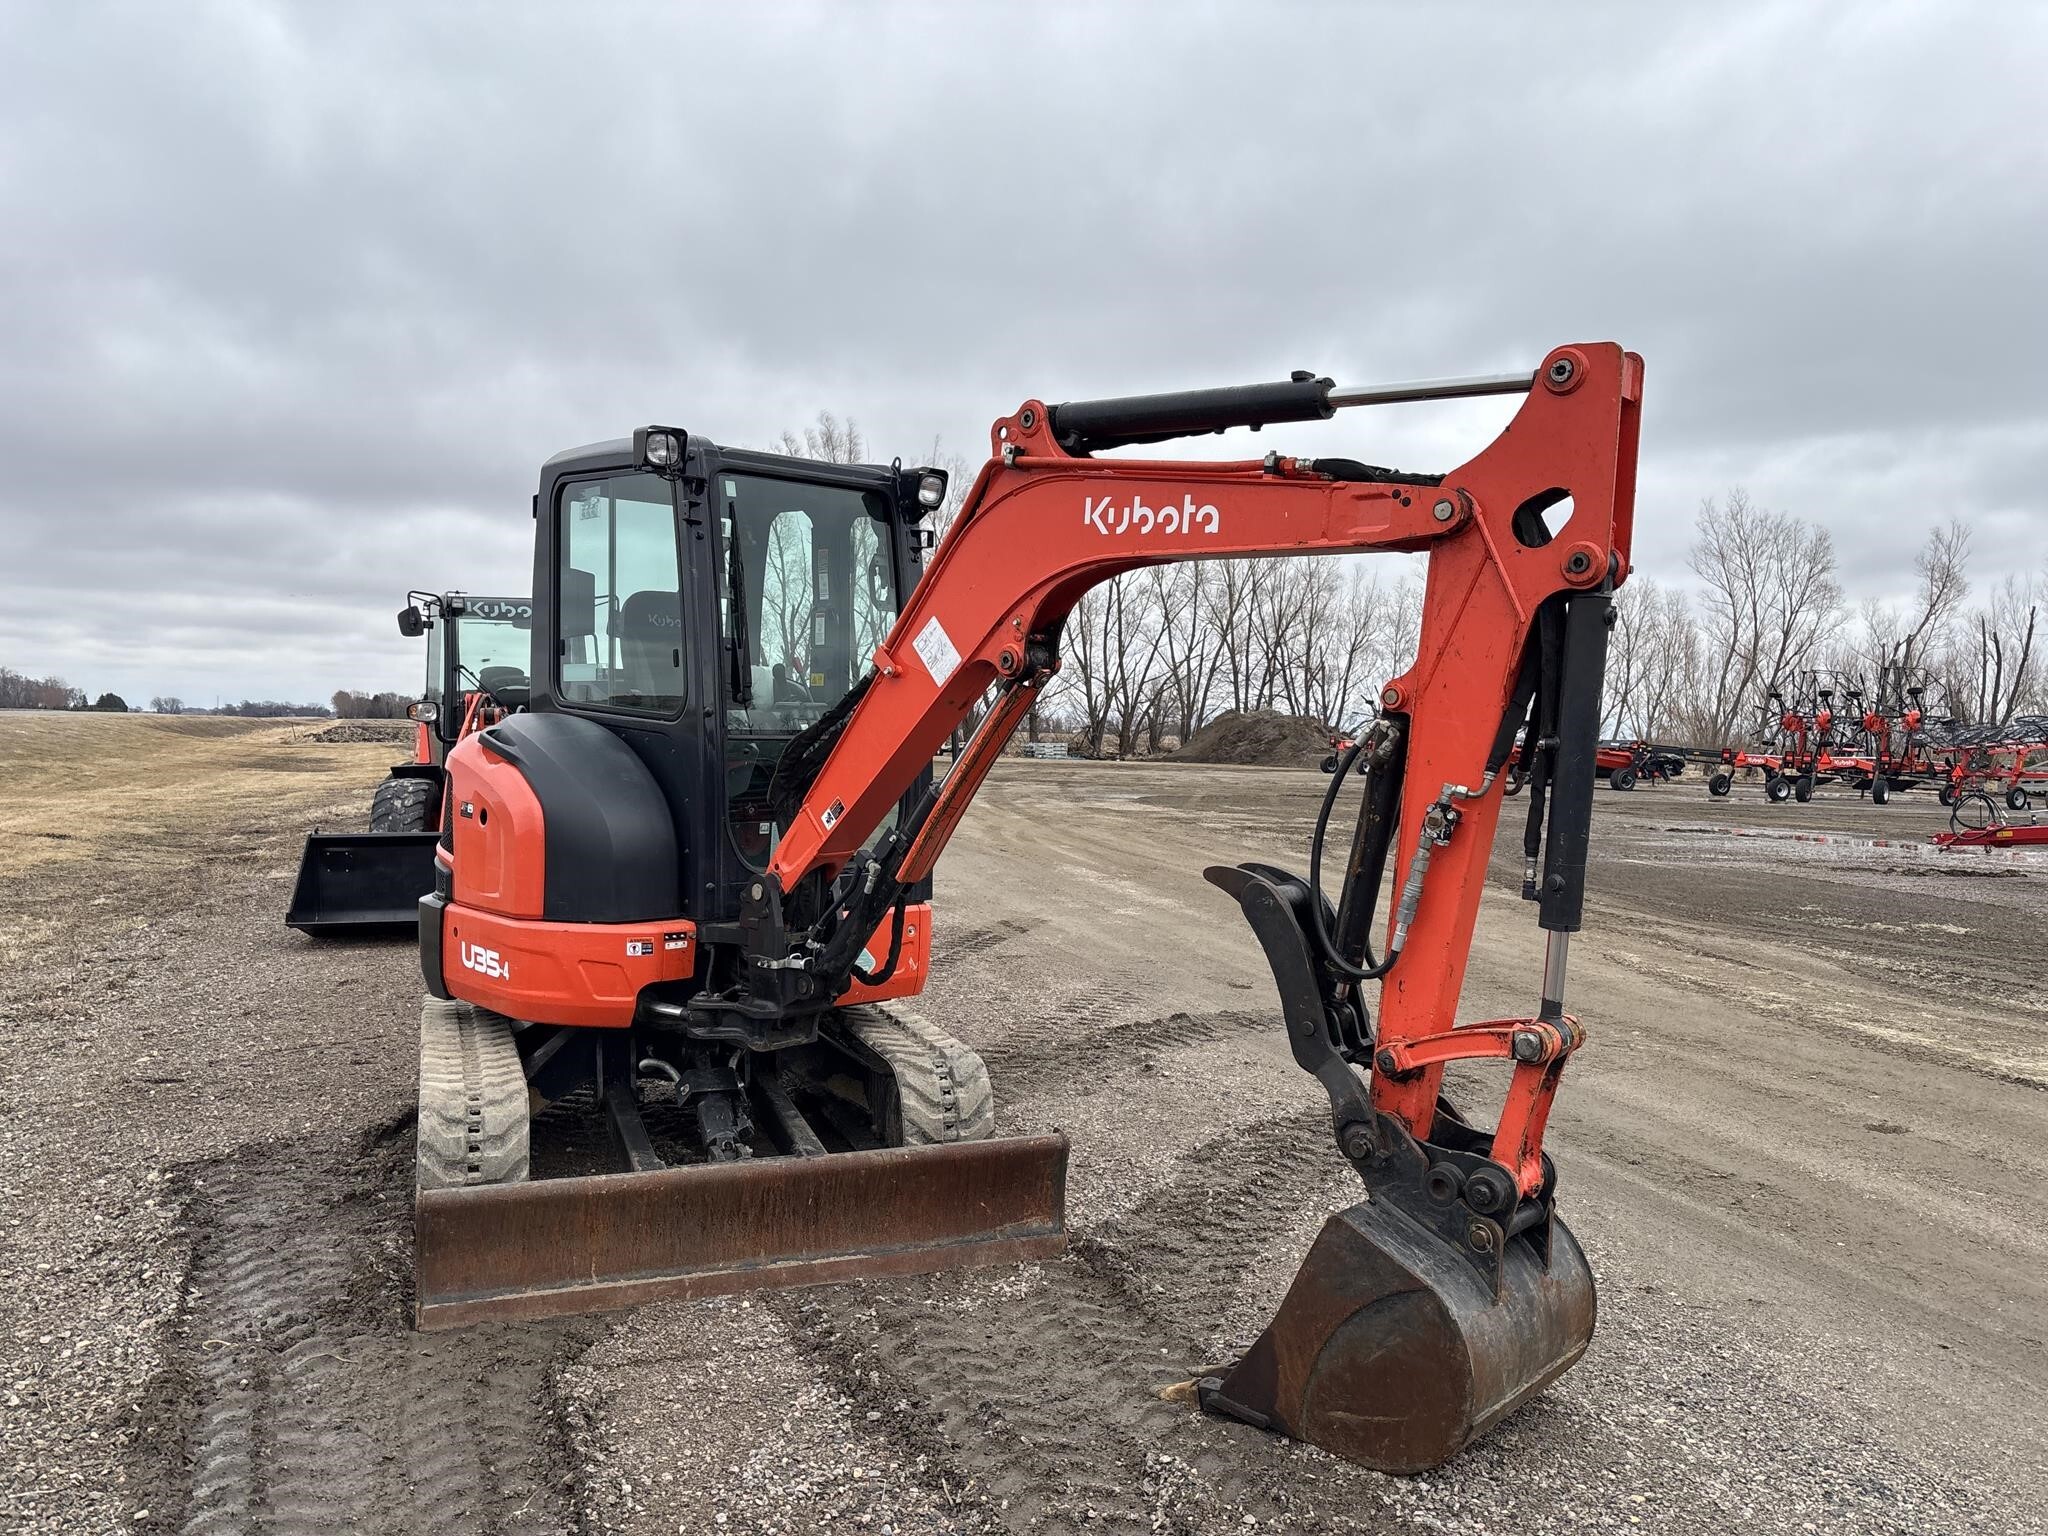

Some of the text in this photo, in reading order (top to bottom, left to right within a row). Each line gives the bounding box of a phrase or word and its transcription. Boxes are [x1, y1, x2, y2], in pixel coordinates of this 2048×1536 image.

[1084, 494, 1220, 535] Kubota
[466, 601, 533, 618] Kubo
[648, 613, 682, 628] Kubo
[461, 940, 510, 981] U35-4
